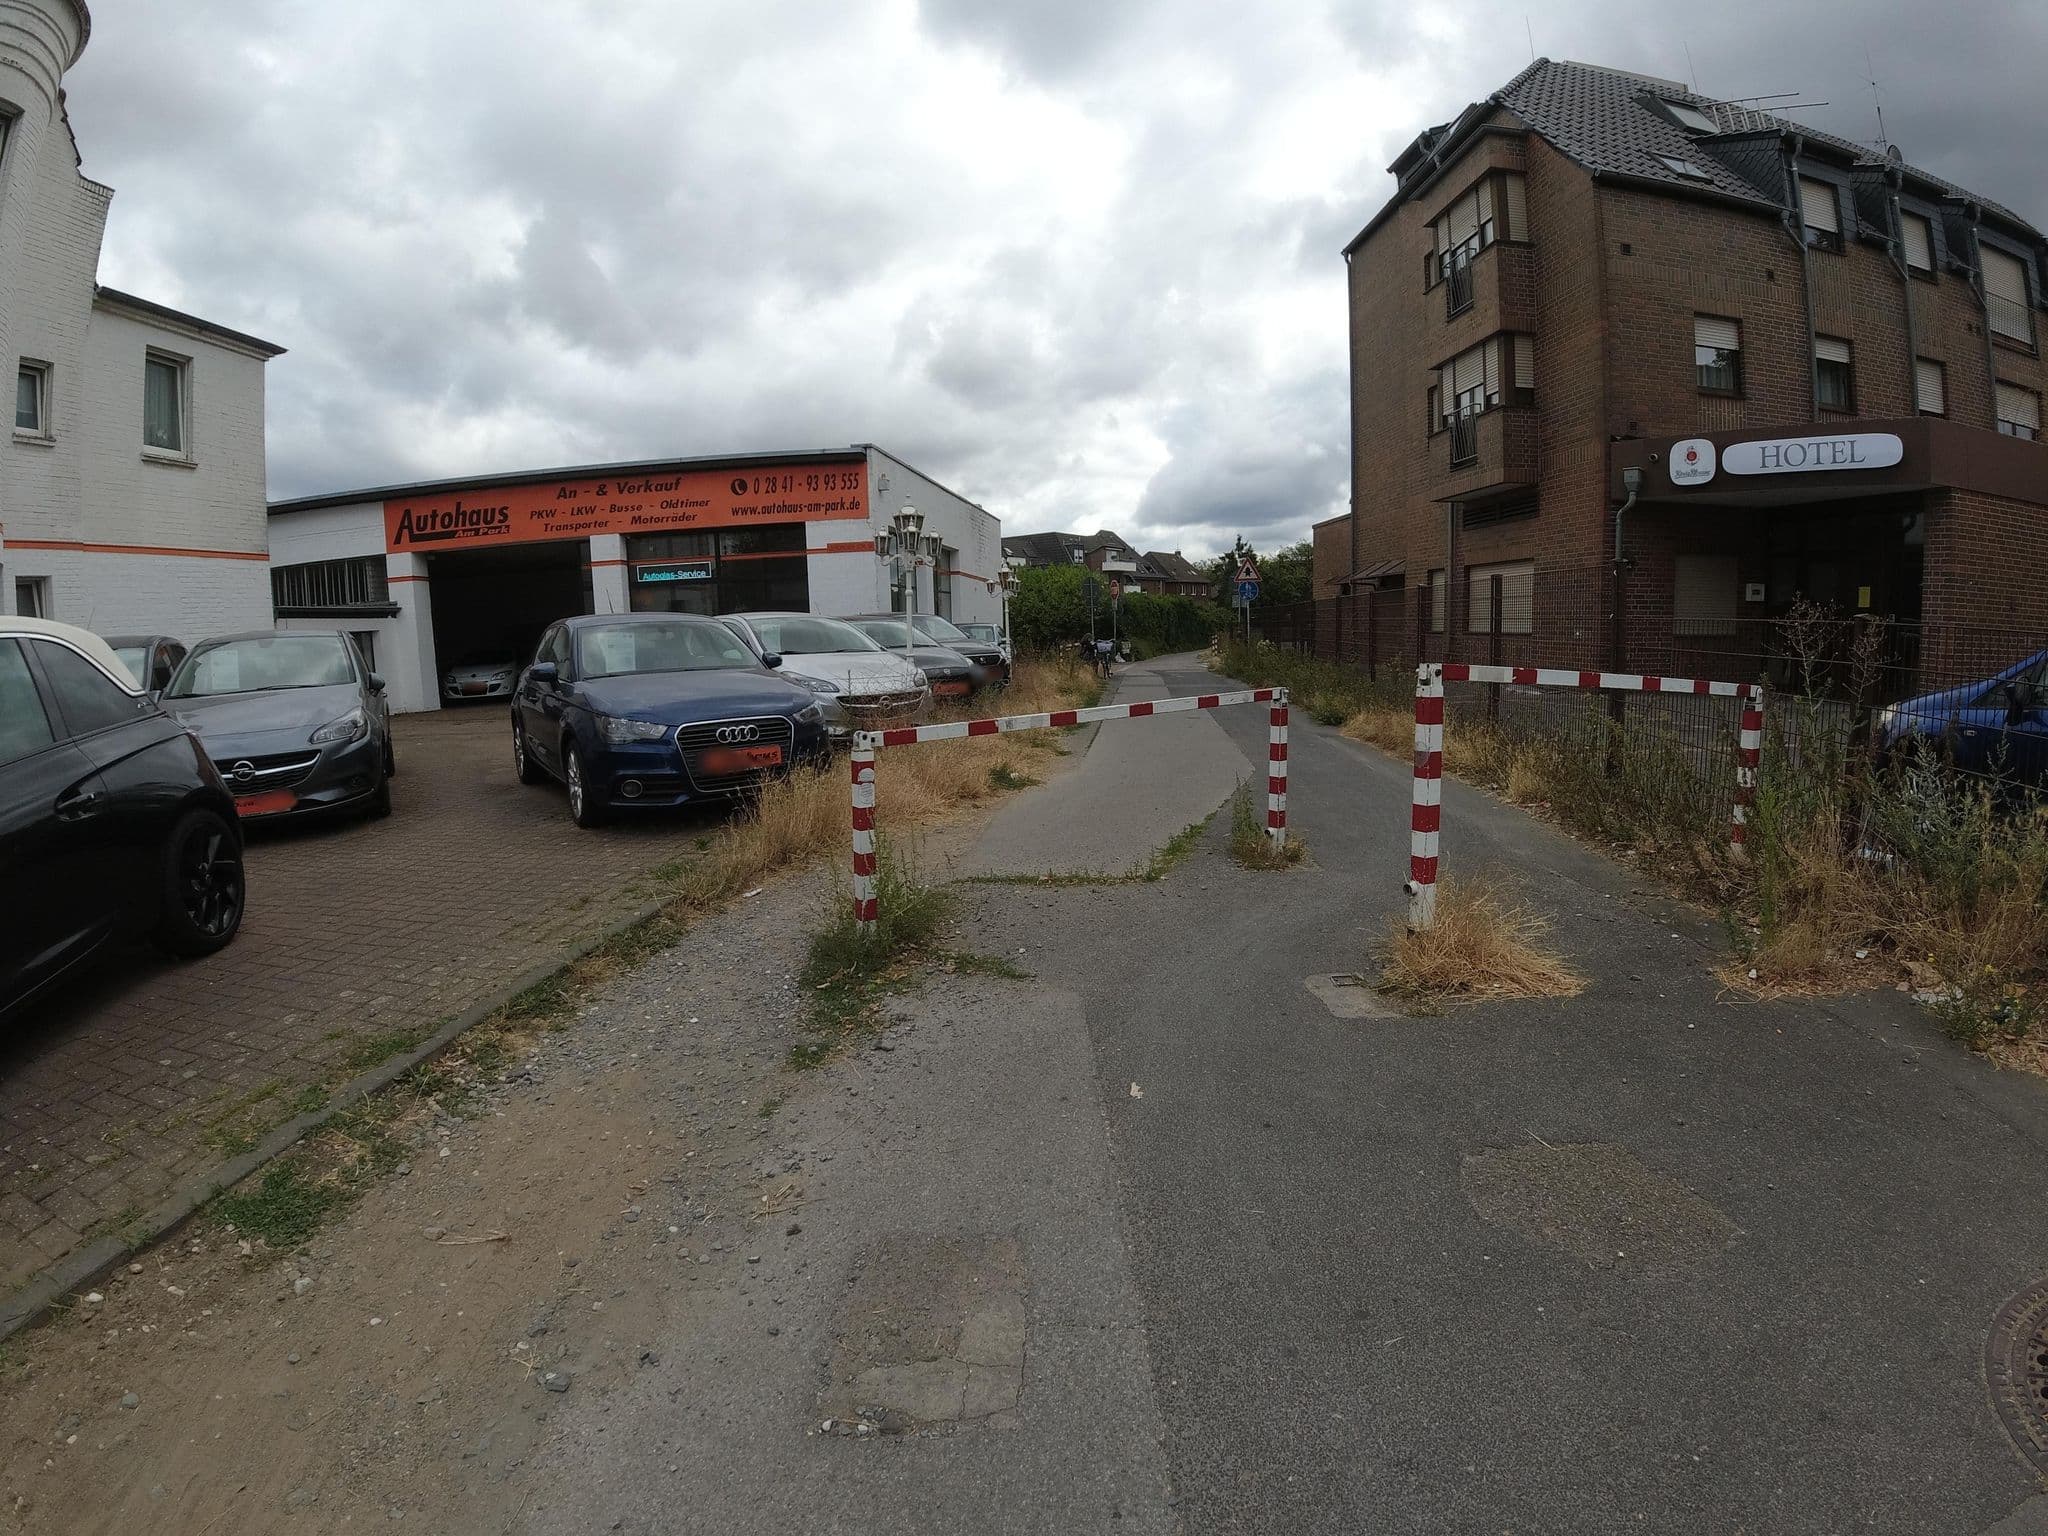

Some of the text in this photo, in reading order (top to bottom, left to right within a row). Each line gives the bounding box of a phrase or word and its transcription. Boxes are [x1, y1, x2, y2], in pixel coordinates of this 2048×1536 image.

[1759, 440, 1866, 469] HOTEL
[556, 486, 577, 500] An
[596, 484, 608, 496] &
[616, 477, 682, 495] Verkauf
[753, 478, 760, 494] 0
[765, 476, 777, 494] 28
[782, 475, 793, 493] 41
[807, 474, 819, 492] 93
[824, 473, 836, 491] 93
[841, 472, 859, 490] 555
[529, 509, 557, 520] PKW
[570, 505, 597, 516] LKW
[608, 503, 643, 513] Busse
[660, 498, 711, 510] Oldtimer
[731, 496, 861, 516] www.autohaus-am-park.de
[393, 501, 510, 545] Autohaus
[454, 524, 510, 538] Am Park
[543, 520, 610, 533] Transporter
[631, 511, 698, 526] Motorräder
